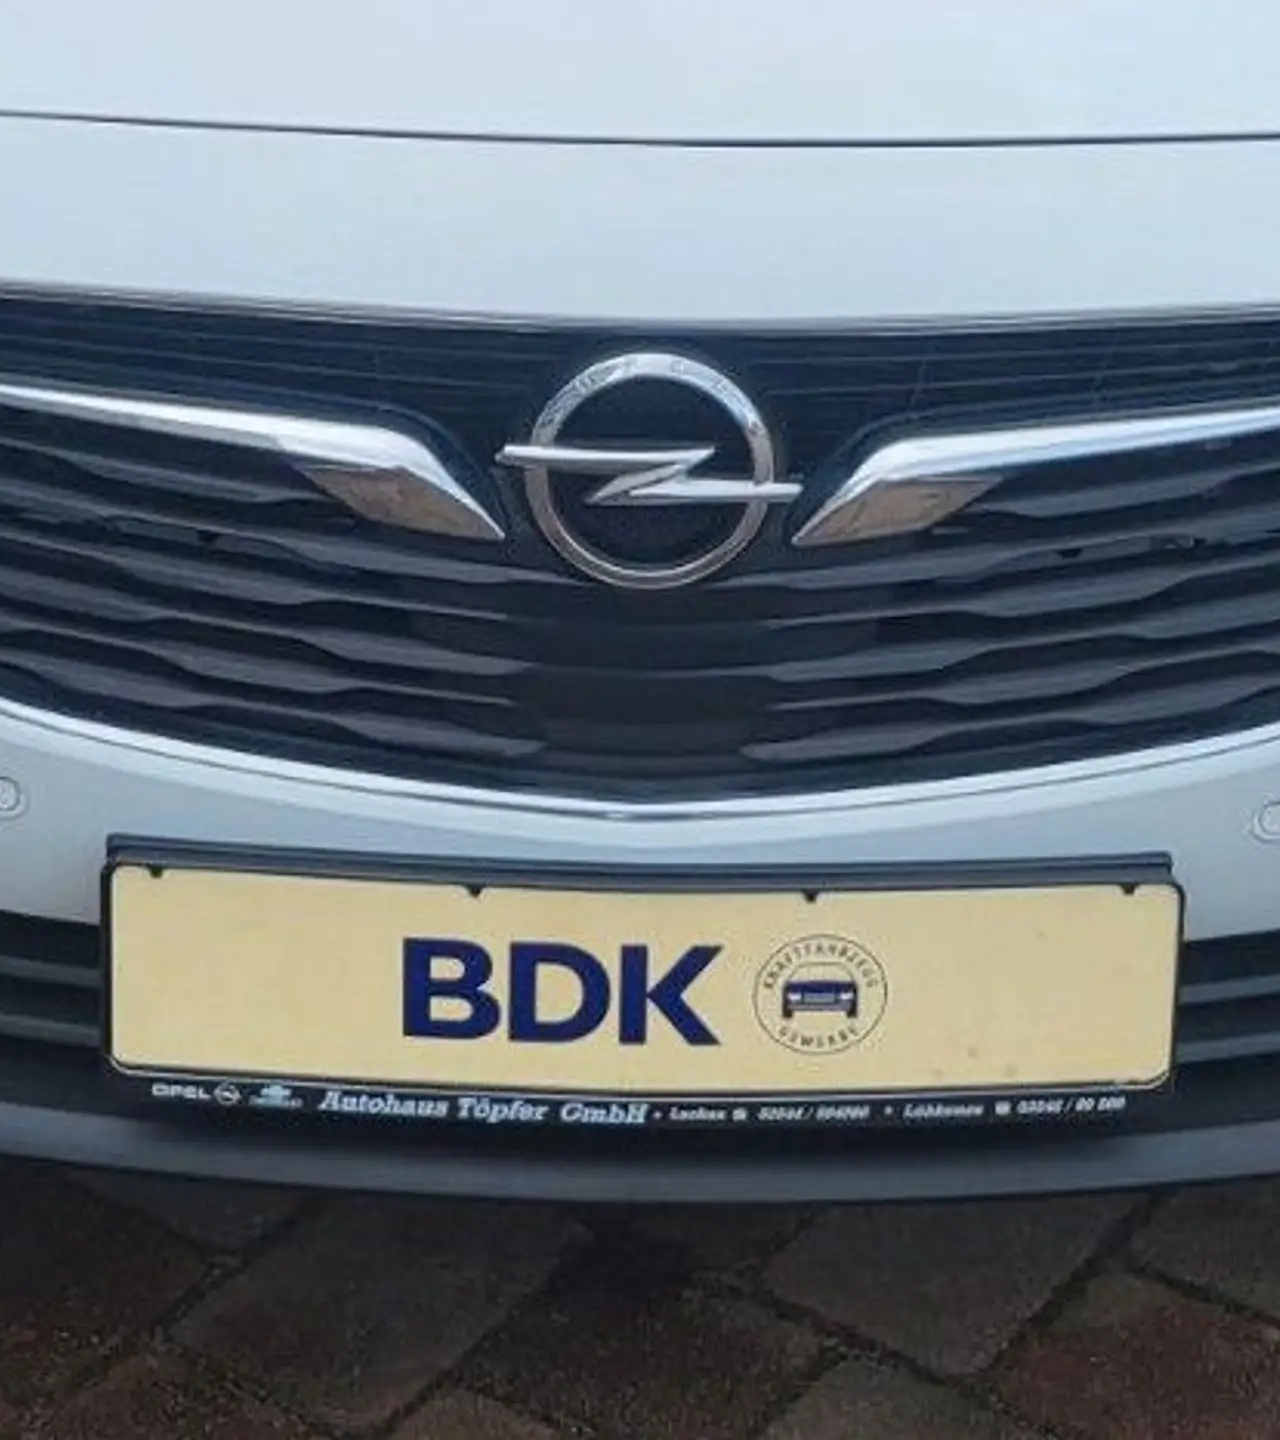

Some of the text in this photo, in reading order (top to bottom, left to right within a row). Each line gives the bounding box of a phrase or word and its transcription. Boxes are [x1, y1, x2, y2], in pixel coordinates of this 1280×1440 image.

[402, 937, 723, 1044] BDK
[151, 1083, 212, 1101] OPEL
[317, 1089, 450, 1118] Autohaus
[456, 1096, 550, 1124] Töpfer
[559, 1101, 651, 1125] GmbH
